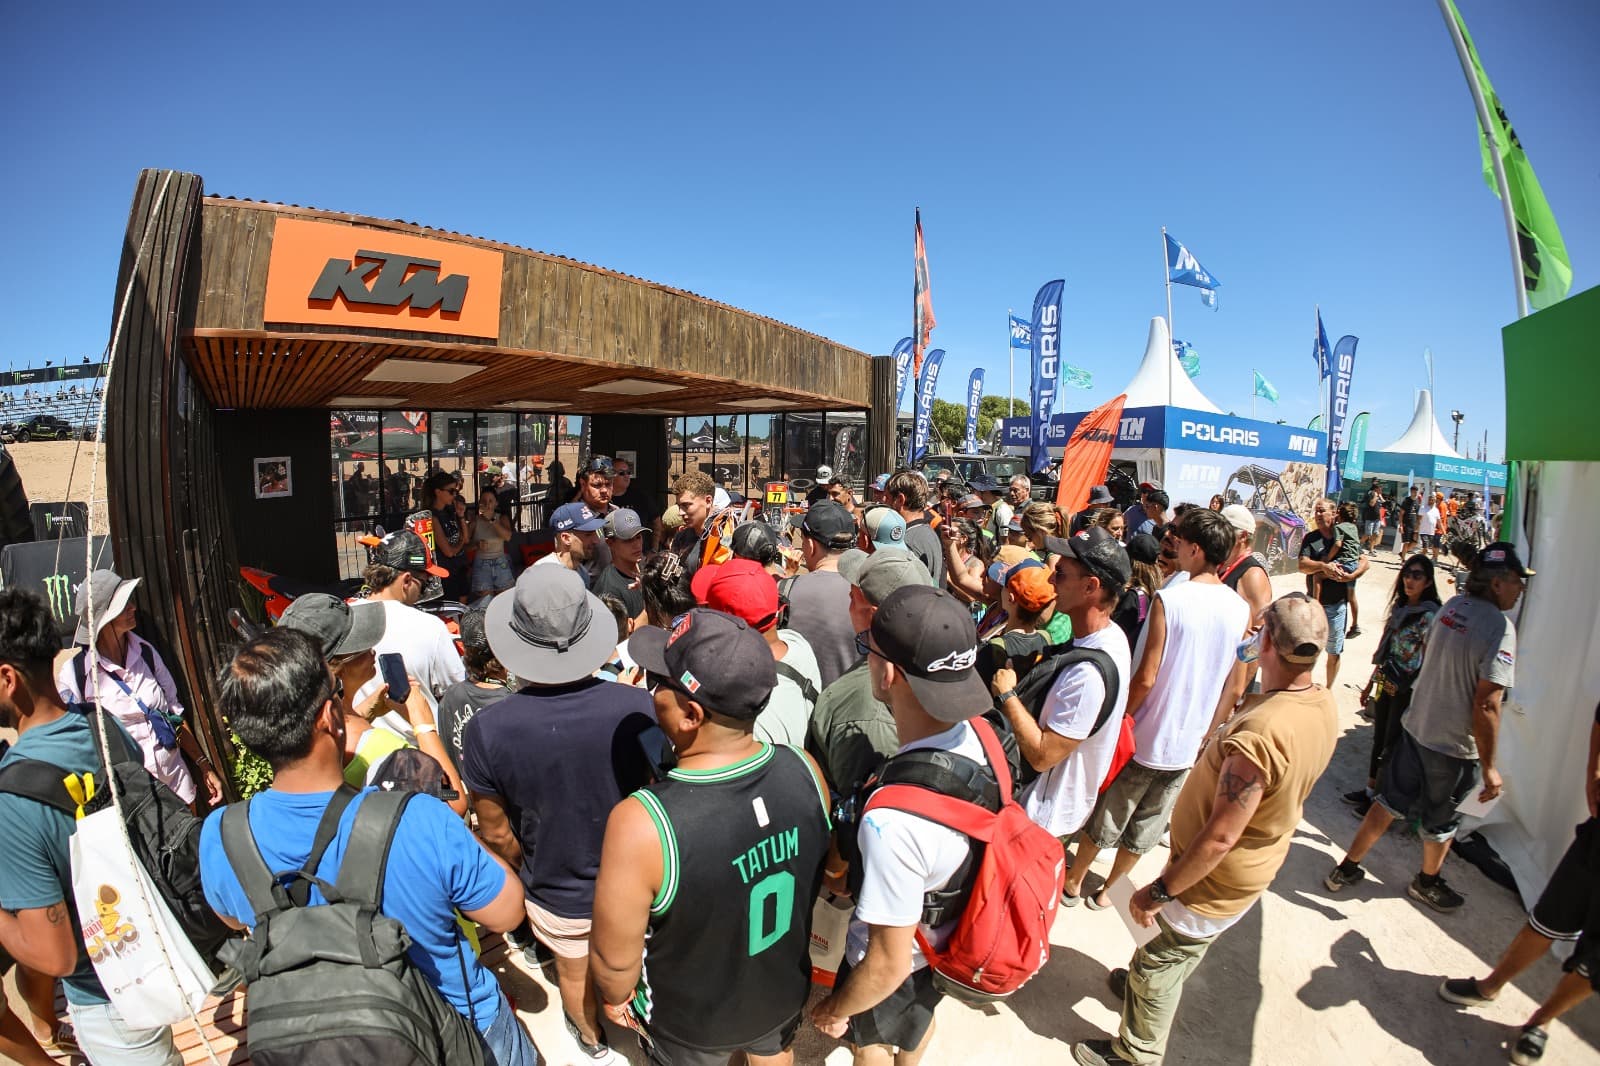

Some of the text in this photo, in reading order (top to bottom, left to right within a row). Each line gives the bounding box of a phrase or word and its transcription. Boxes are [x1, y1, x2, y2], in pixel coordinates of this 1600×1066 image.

[307, 249, 470, 320] KTM
[916, 362, 938, 448] POLARIS
[1119, 417, 1146, 435] TN
[1181, 421, 1260, 447] POLARIS
[1287, 434, 1318, 453] MTN
[1179, 463, 1222, 482] MTN
[772, 492, 782, 502] 77
[732, 827, 799, 884] TATUM
[749, 870, 796, 957] 0
